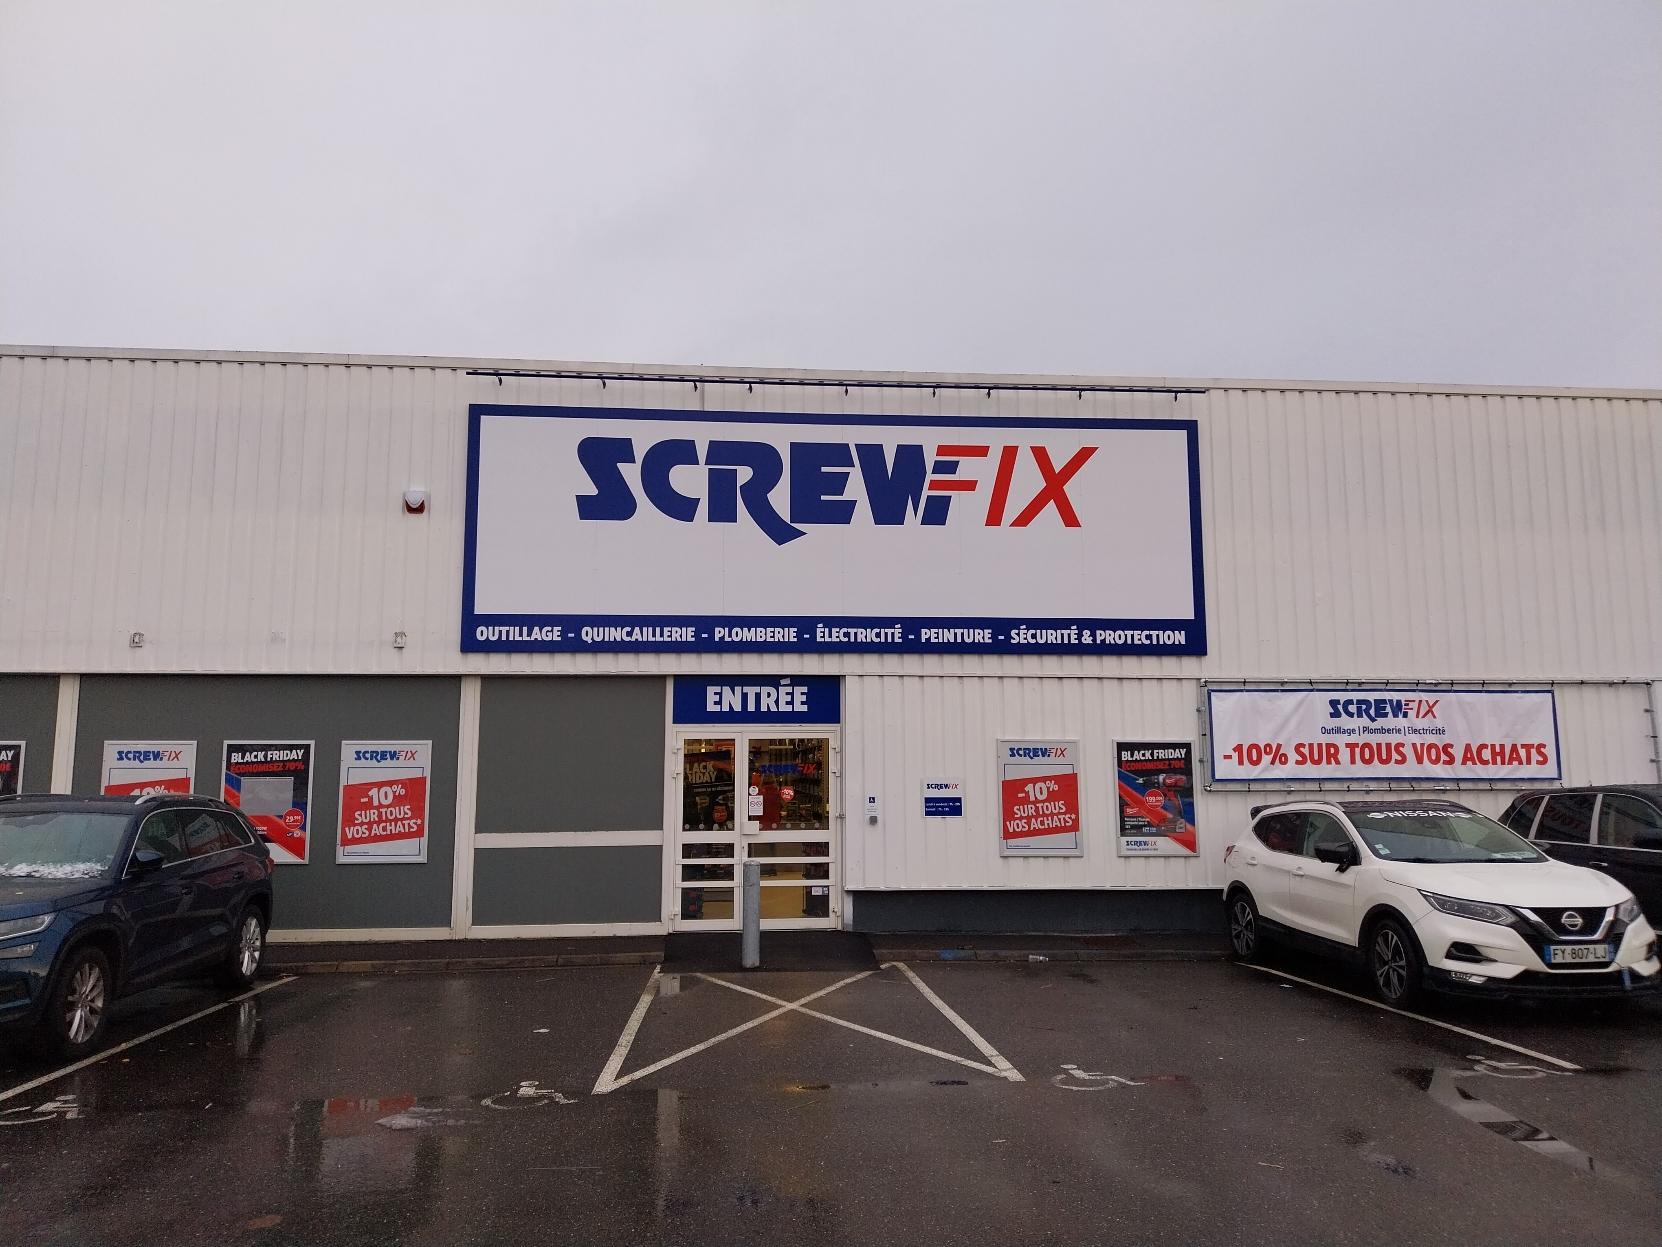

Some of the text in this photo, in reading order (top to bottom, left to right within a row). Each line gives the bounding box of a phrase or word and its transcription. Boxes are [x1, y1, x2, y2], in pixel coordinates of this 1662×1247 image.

[575, 436, 1100, 546] SCREWFIX
[476, 626, 562, 641] OUTILLAGE
[581, 626, 696, 644] QUINCAILLERIE
[714, 627, 797, 642] PLOMBERIE
[816, 624, 902, 643] ÉLECTRICITÉ
[921, 628, 992, 644] PEINTURE
[1010, 625, 1079, 644] SÉCURITÉ
[1081, 631, 1094, 644] &
[1096, 630, 1186, 645] PROTECTION
[706, 677, 808, 712] ENTRÉE
[1328, 698, 1440, 723] SCREWFIX
[1320, 726, 1357, 736] Outillage
[1362, 726, 1402, 735] Plomberie
[116, 750, 183, 764] SCREWFIX
[230, 749, 305, 763] BLACK FRIDAY
[354, 750, 418, 763] SCREWFIX
[1008, 747, 1068, 760] SCREWFIX
[1121, 748, 1187, 761] BLACK FRIDAY
[1223, 742, 1549, 766] -10% SUR TOUS VOS ACHATS
[360, 784, 406, 807] -10%
[1017, 780, 1059, 801] -10%
[354, 805, 412, 824] SUR TOUS
[1013, 800, 1066, 818] SUR TOUS
[345, 824, 369, 839] VOS
[1006, 819, 1028, 833] VOS
